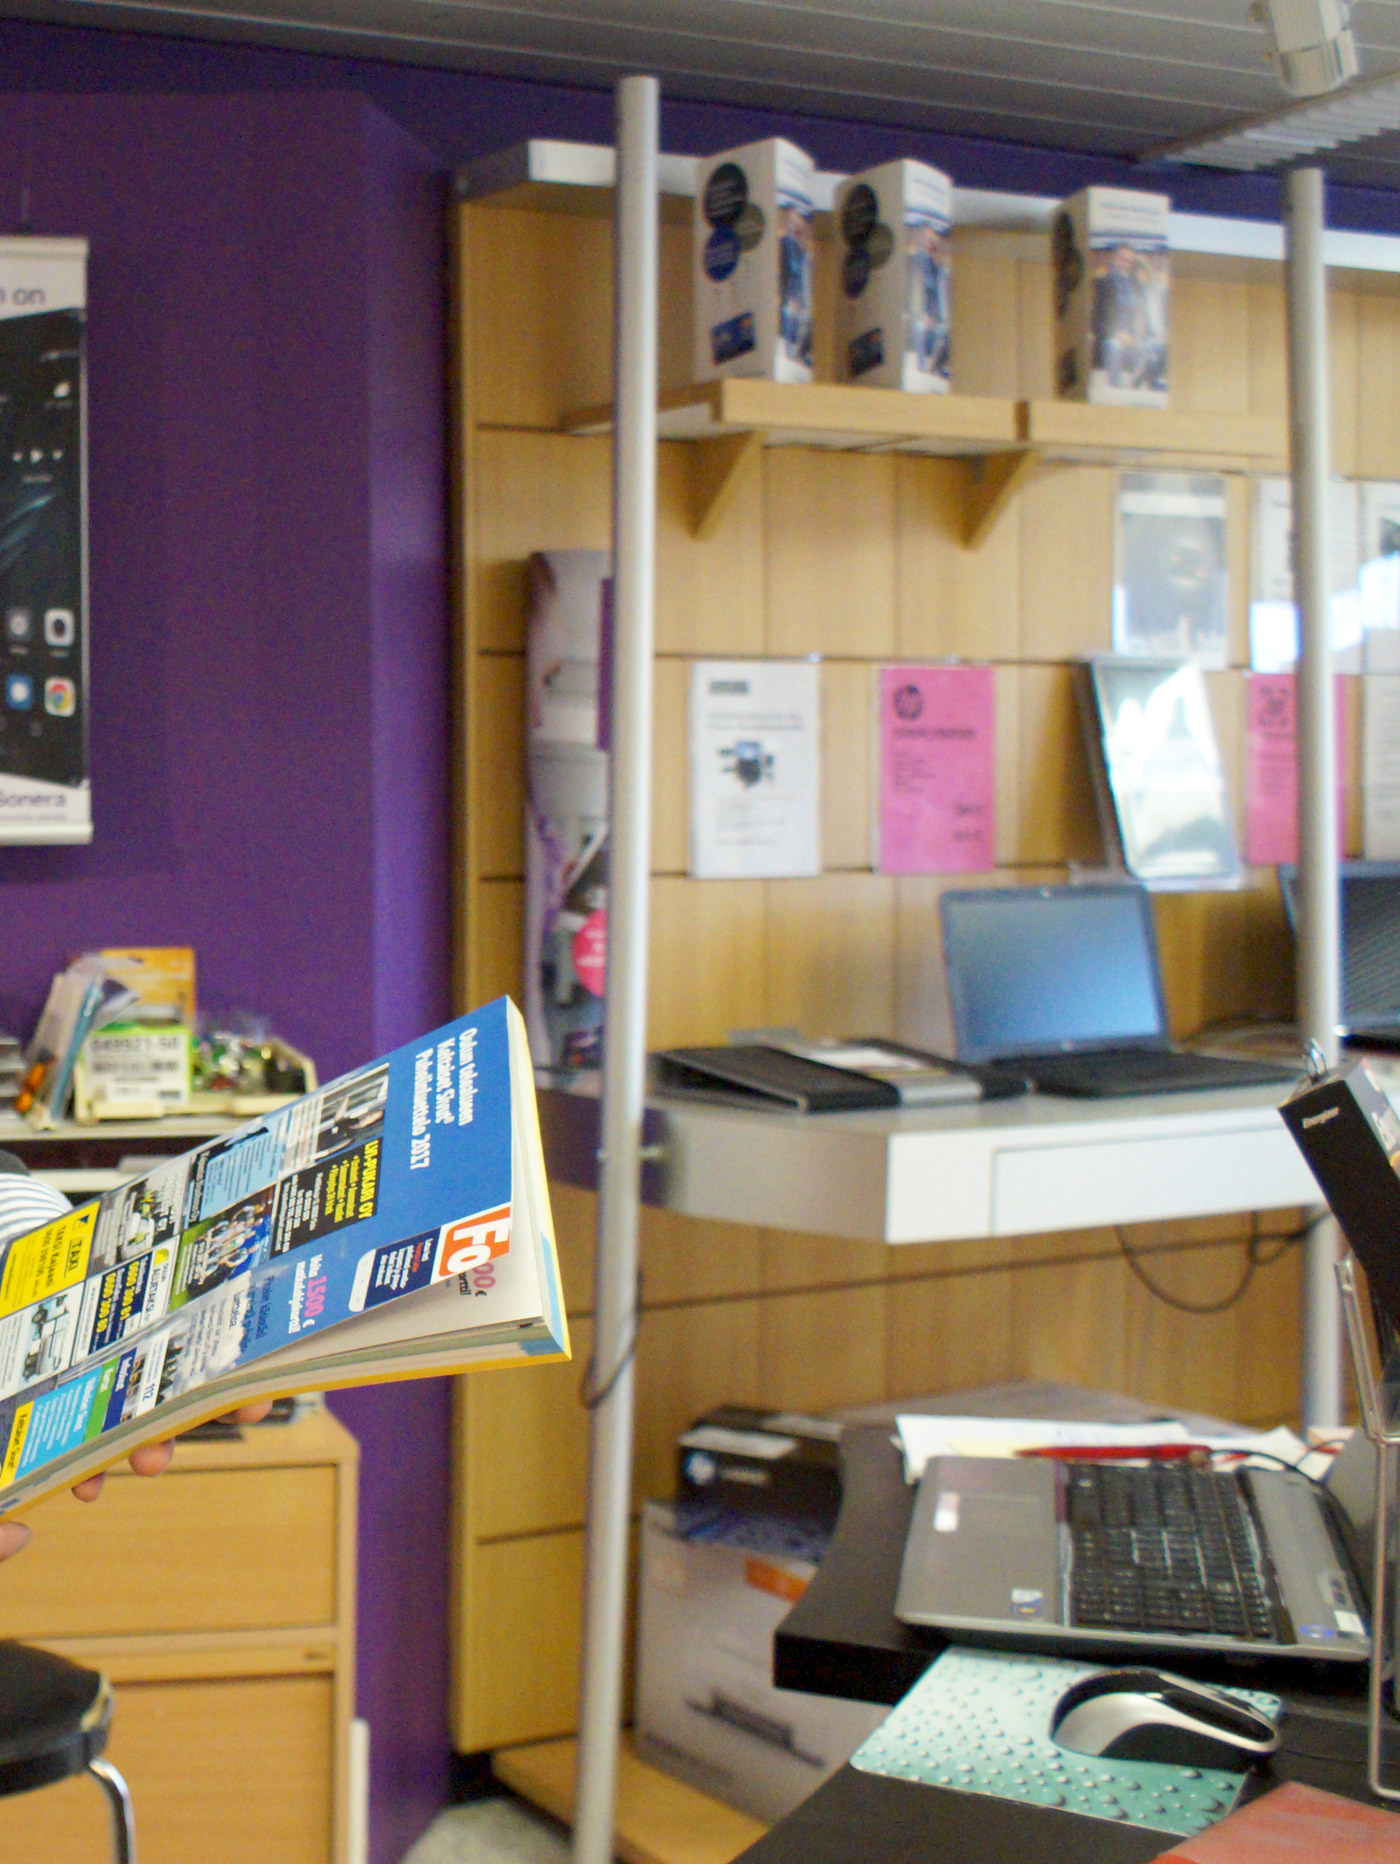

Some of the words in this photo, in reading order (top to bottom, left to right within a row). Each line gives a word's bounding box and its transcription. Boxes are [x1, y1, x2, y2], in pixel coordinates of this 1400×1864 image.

[12, 288, 46, 304] on
[436, 1036, 454, 1092] Keltaiset
[459, 1026, 477, 1066] Oulun
[411, 1047, 432, 1137] Puhelinluettelo
[410, 1133, 429, 1170] 2017
[359, 1138, 378, 1203] LVI-PUKARI
[358, 1199, 373, 1219] OY
[52, 1225, 66, 1251] TAKSI
[67, 1239, 82, 1271] TAXI
[303, 1274, 327, 1319] 1500
[142, 1382, 154, 1400] 112
